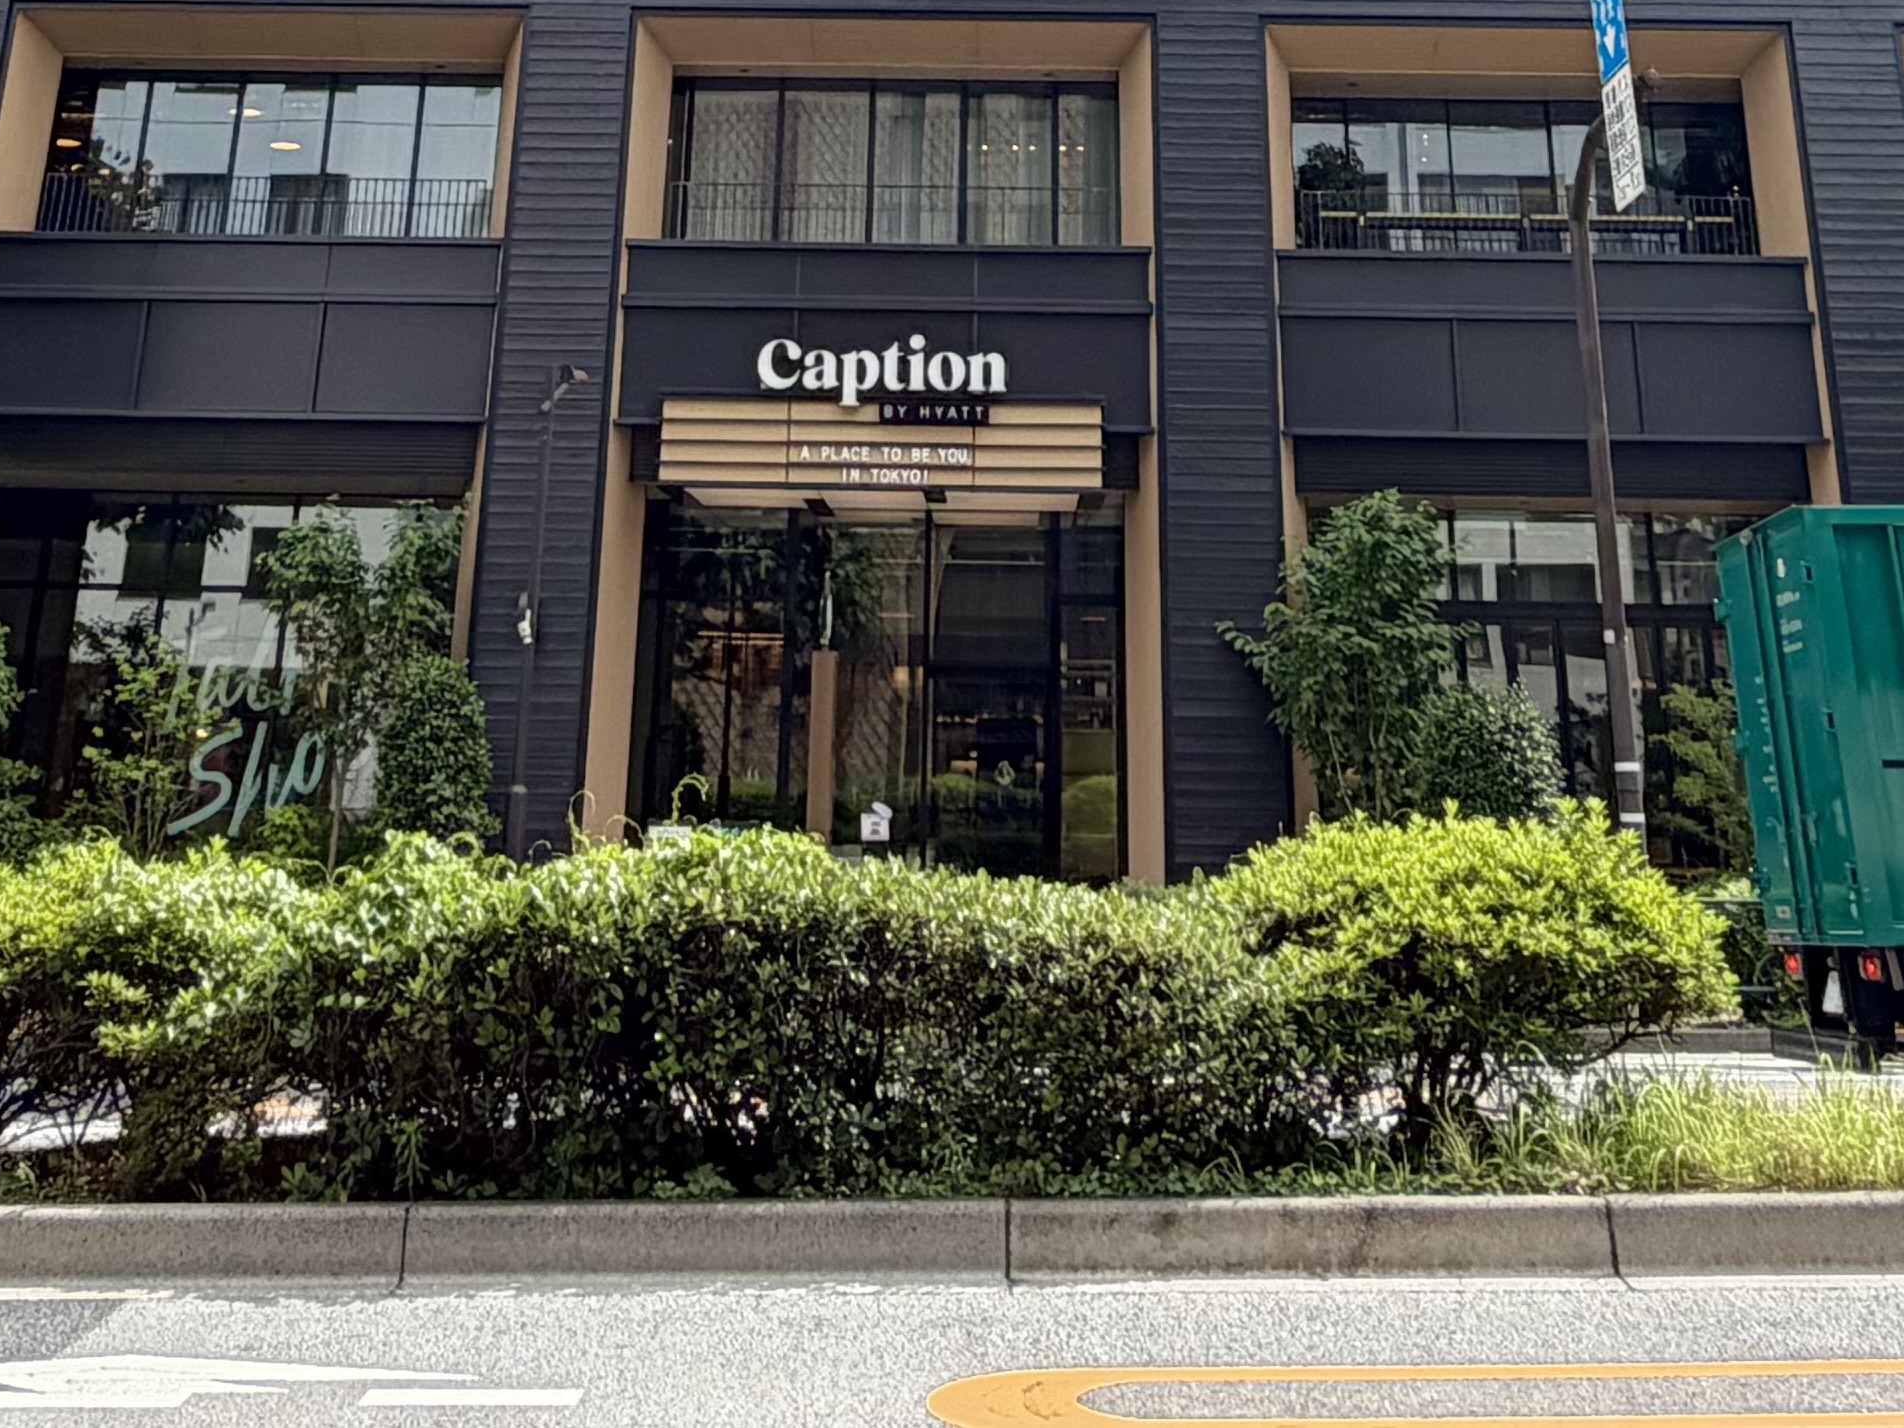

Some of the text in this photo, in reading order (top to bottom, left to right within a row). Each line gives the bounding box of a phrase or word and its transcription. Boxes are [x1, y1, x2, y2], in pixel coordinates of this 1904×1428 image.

[756, 334, 1007, 407] Caption
[883, 404, 984, 421] BY HYATT
[800, 445, 811, 460] A
[821, 446, 870, 462] PLACE
[881, 447, 902, 462] TO
[911, 448, 931, 463] BE
[842, 467, 928, 485] IN TOKYO!
